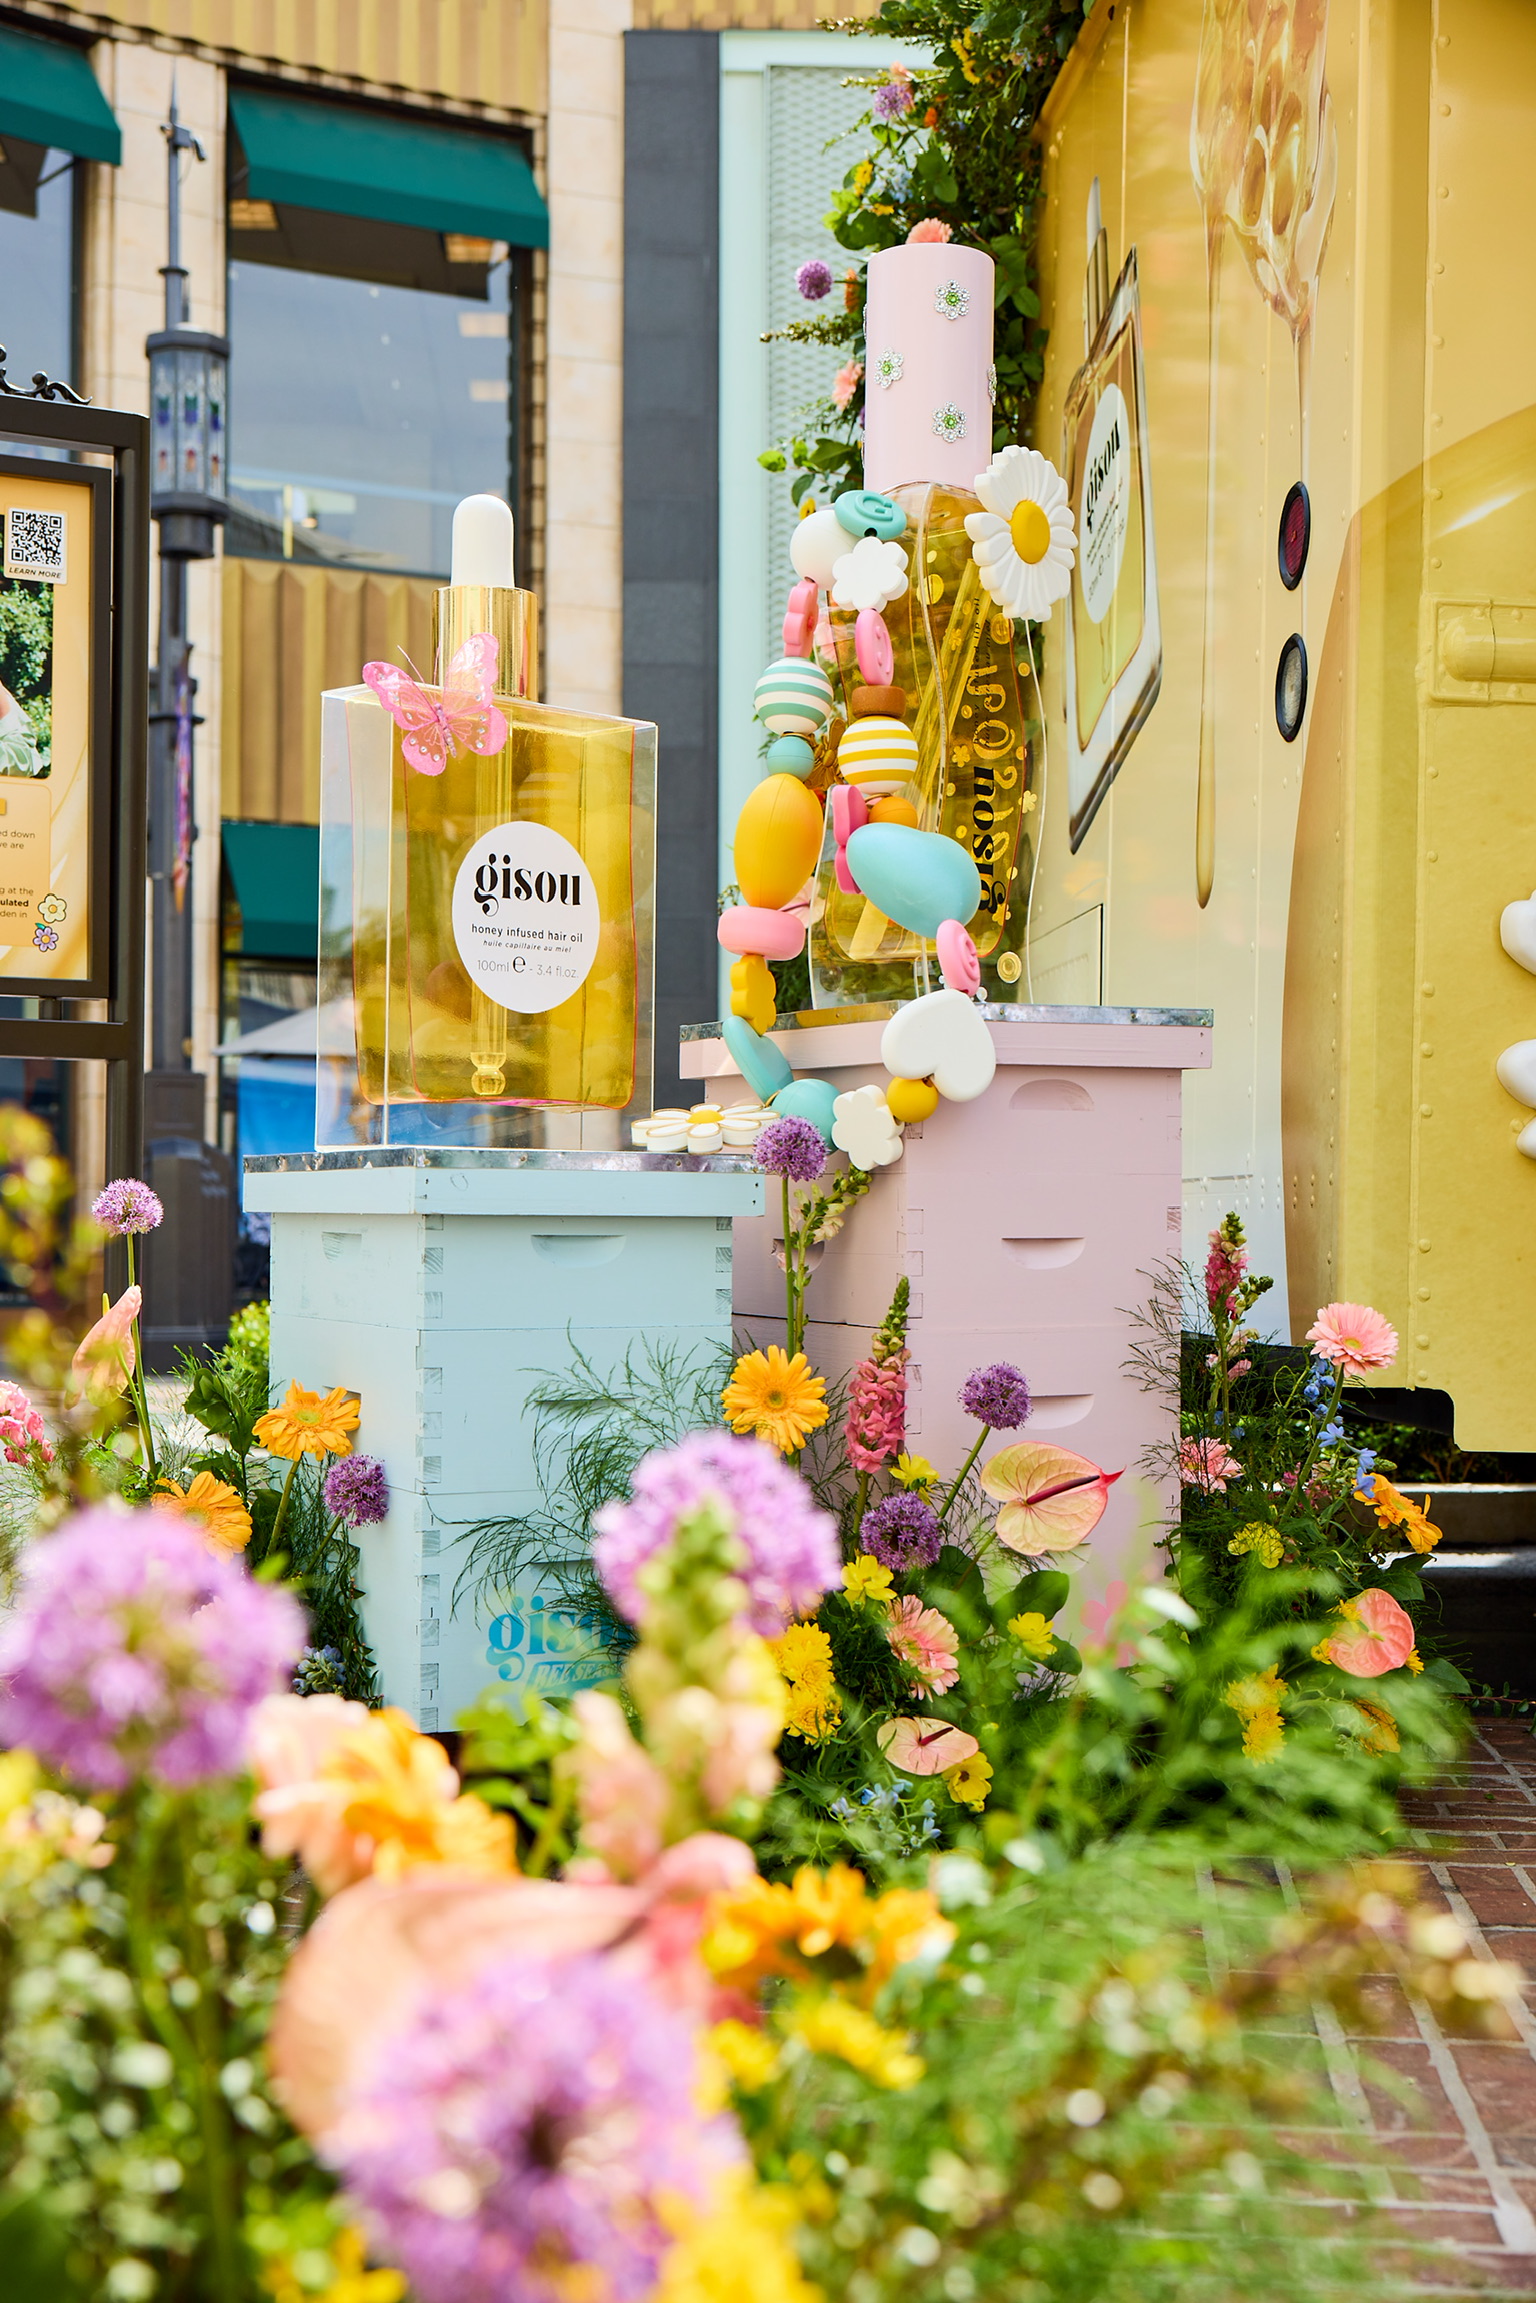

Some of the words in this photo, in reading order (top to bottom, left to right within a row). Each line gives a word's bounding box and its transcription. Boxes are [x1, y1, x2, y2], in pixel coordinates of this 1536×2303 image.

[1086, 419, 1120, 534] gisou
[9, 567, 36, 575] LEARN
[10, 830, 36, 838] down
[973, 766, 1006, 914] gisou
[10, 842, 25, 850] are
[7, 887, 17, 895] at
[19, 887, 34, 896] the
[473, 853, 582, 917] gisou
[19, 910, 28, 918] in
[471, 923, 503, 938] honey
[506, 926, 544, 940] infused
[547, 929, 567, 942] hair
[570, 932, 583, 943] oil
[482, 940, 503, 948] huile
[505, 941, 541, 951] capillaire
[555, 945, 572, 953] miel
[477, 959, 510, 973] 100ml
[536, 964, 552, 977] 3.4
[555, 965, 579, 979] fl.oz.
[486, 1595, 634, 1682] giso
